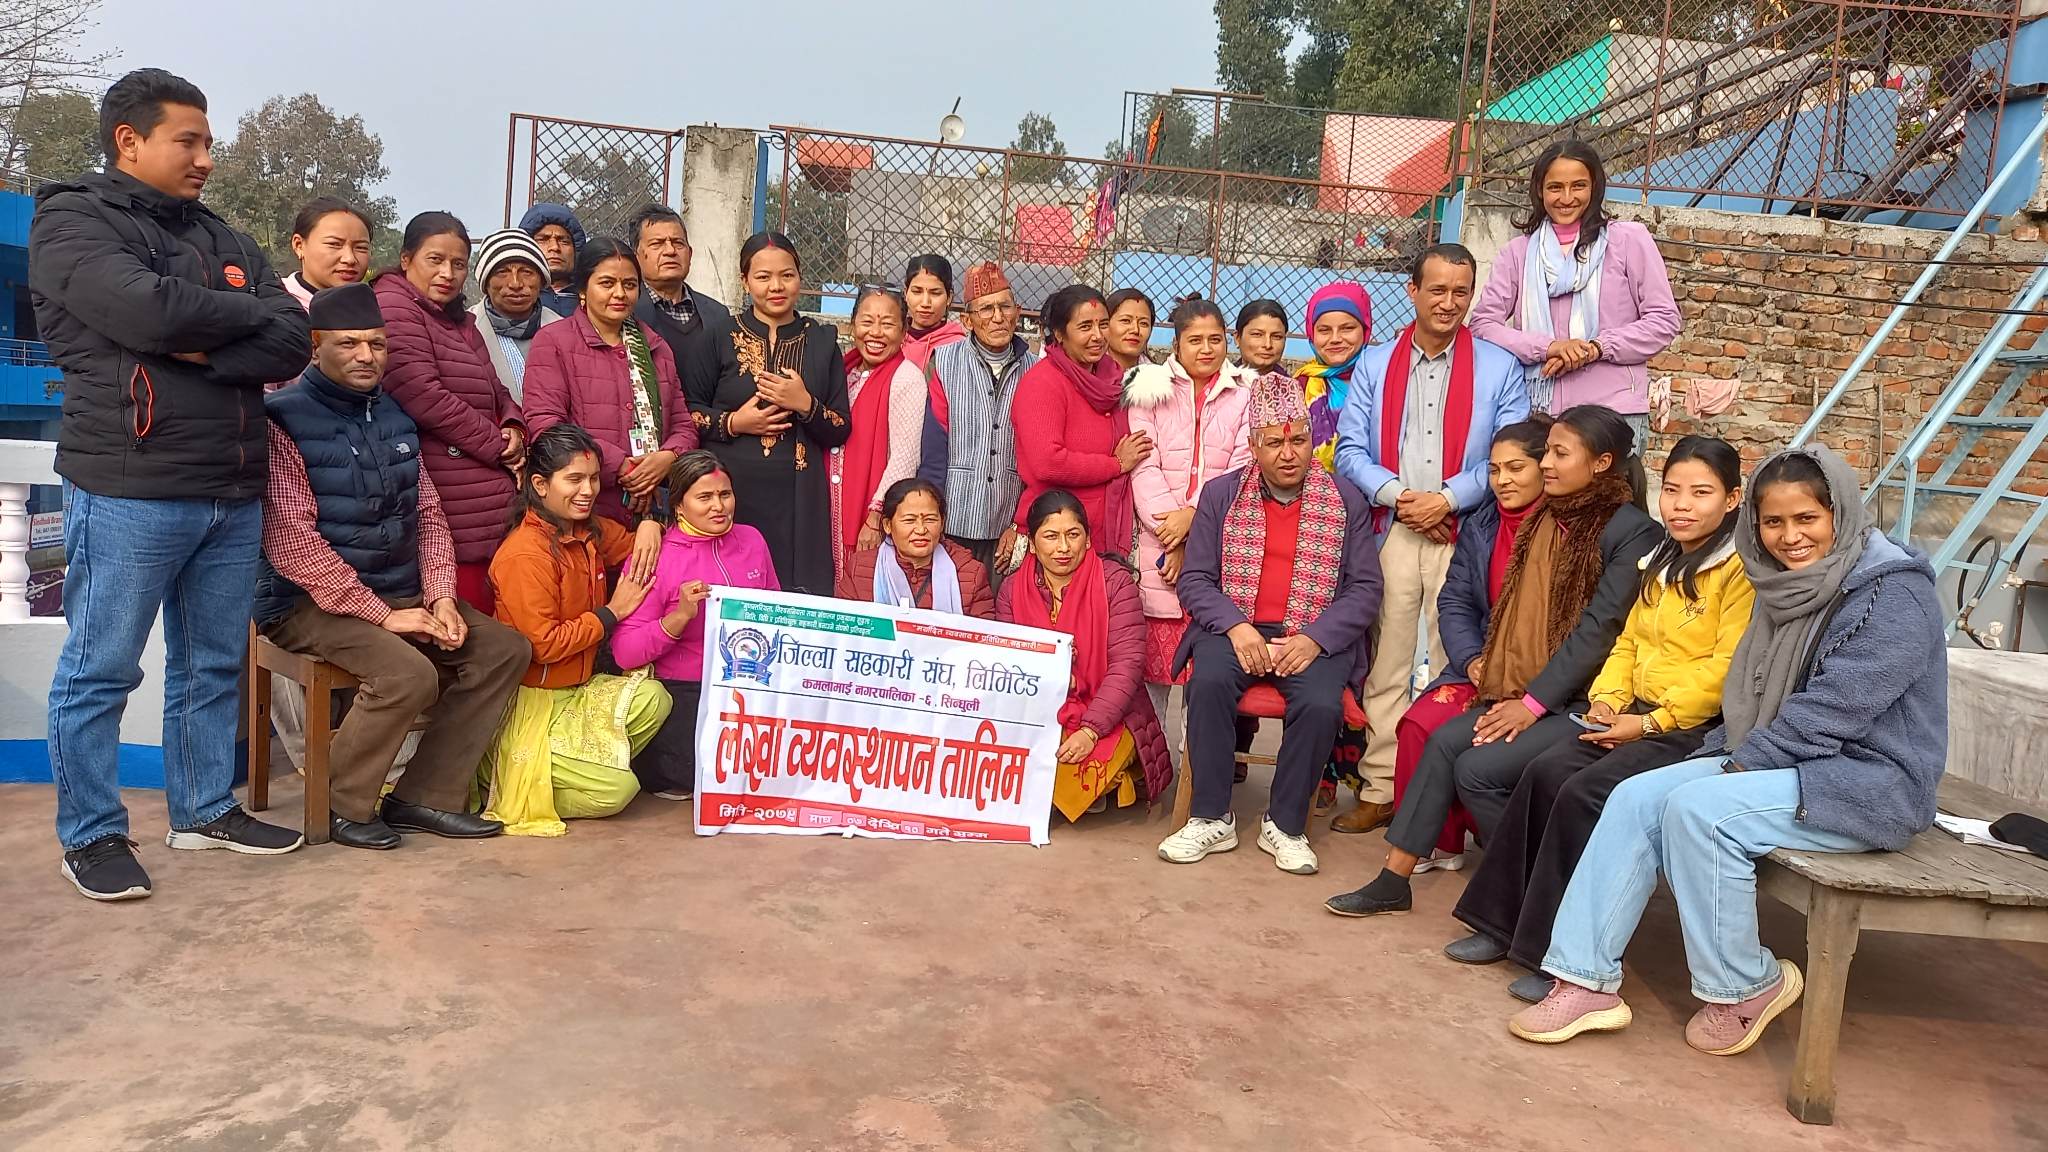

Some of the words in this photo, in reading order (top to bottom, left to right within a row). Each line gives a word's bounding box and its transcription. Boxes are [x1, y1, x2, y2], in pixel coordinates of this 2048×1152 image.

[777, 634, 837, 670] जिल्ला
[844, 648, 915, 681] सहकारी
[965, 659, 1041, 697] लिमिटेड
[802, 678, 853, 695] कमलामाई
[855, 685, 916, 703] नगरपालिका
[941, 693, 980, 713] सिन्धुली
[715, 688, 787, 793] लेखा
[786, 720, 940, 804] व्यवस्थापन
[939, 719, 1031, 812] तालिम
